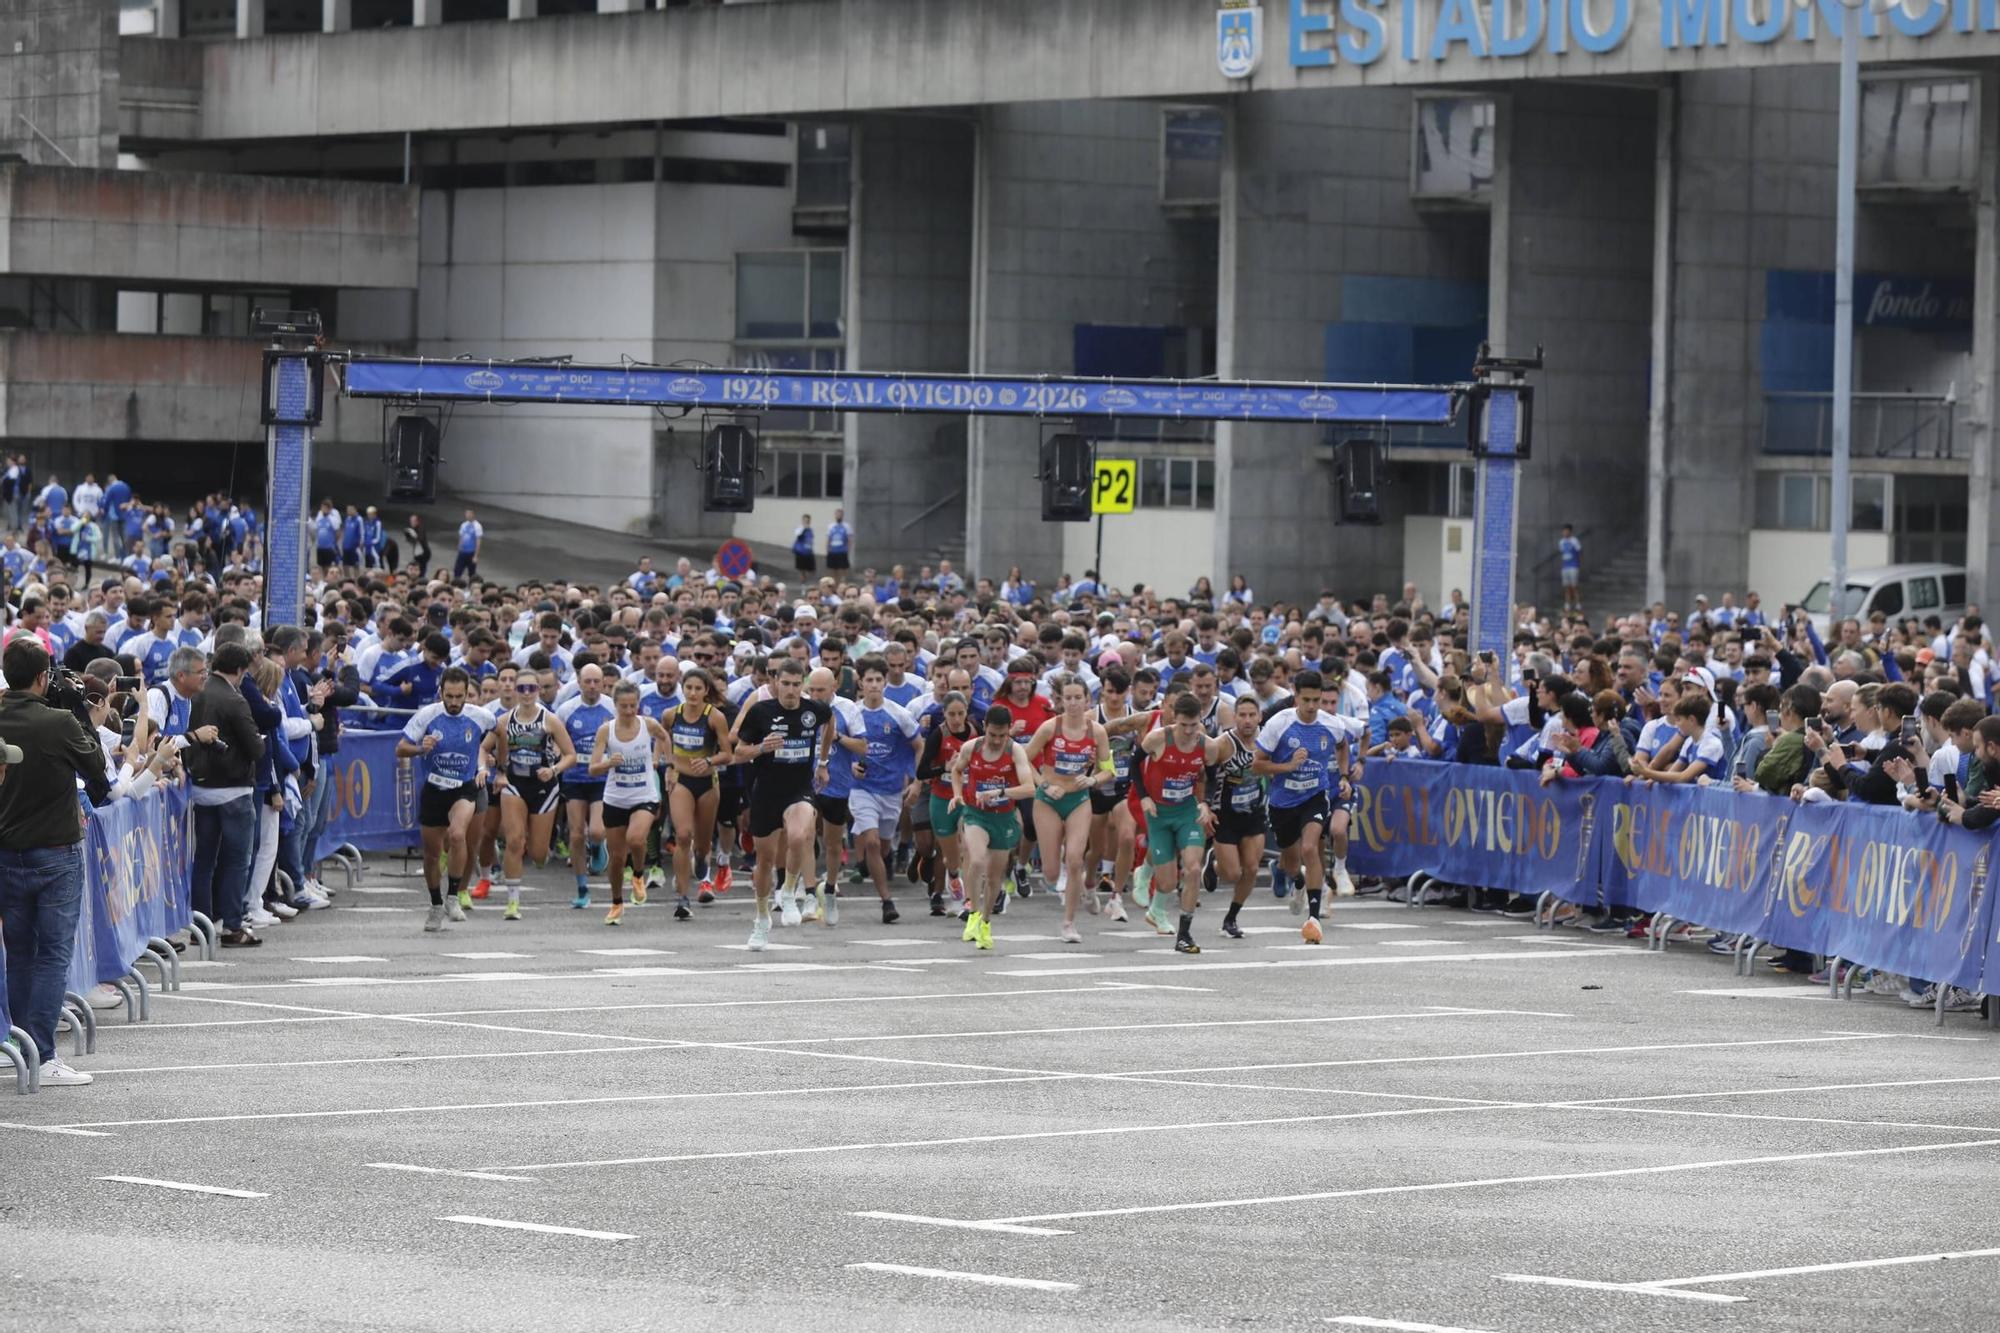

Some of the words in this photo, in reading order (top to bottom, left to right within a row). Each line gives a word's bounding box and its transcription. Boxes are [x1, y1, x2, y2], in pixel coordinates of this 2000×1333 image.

[1290, 0, 1629, 66] ESTADIO
[1866, 280, 1939, 325] fondo
[570, 375, 592, 384] DIGI
[722, 378, 780, 400] 1926
[811, 381, 882, 404] REAL
[887, 383, 993, 407] OVIEDO
[1022, 386, 1087, 409] 2026
[1097, 468, 1130, 504] P2
[1350, 784, 1437, 851] REAL
[1443, 787, 1561, 860] OVIEDO
[1613, 802, 1673, 880] REAL
[1679, 811, 1760, 893] OVIEDO
[1777, 831, 1854, 918] REAL
[1854, 840, 1957, 933] OVIEDO
